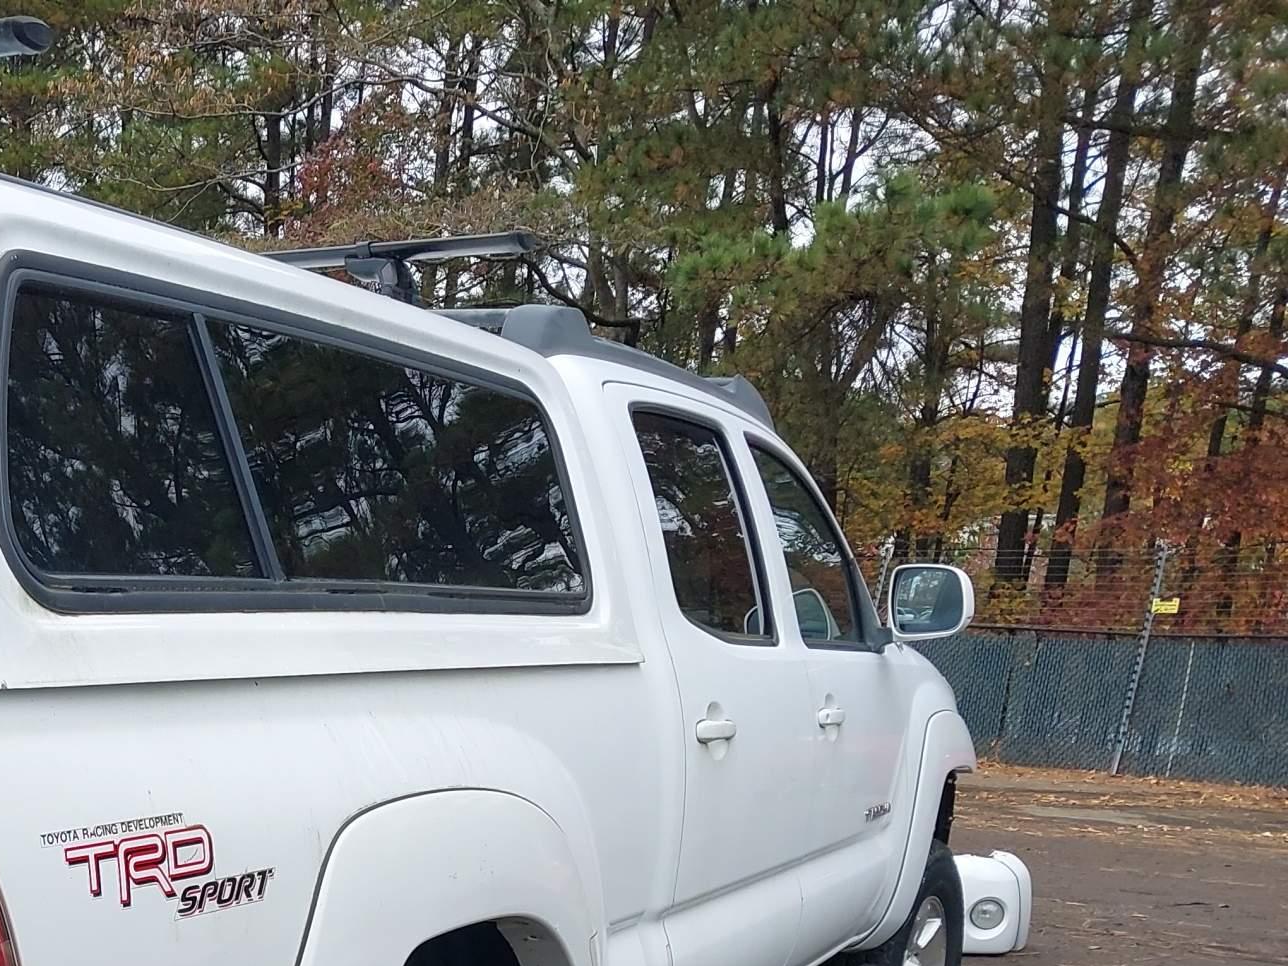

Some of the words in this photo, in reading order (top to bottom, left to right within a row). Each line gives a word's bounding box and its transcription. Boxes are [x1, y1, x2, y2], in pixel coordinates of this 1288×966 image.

[40, 830, 80, 846] TOYOTA
[82, 823, 119, 840] RACING
[120, 813, 184, 833] DEVELOPMENT
[64, 825, 214, 907] TRD
[177, 867, 274, 917] SPORT
